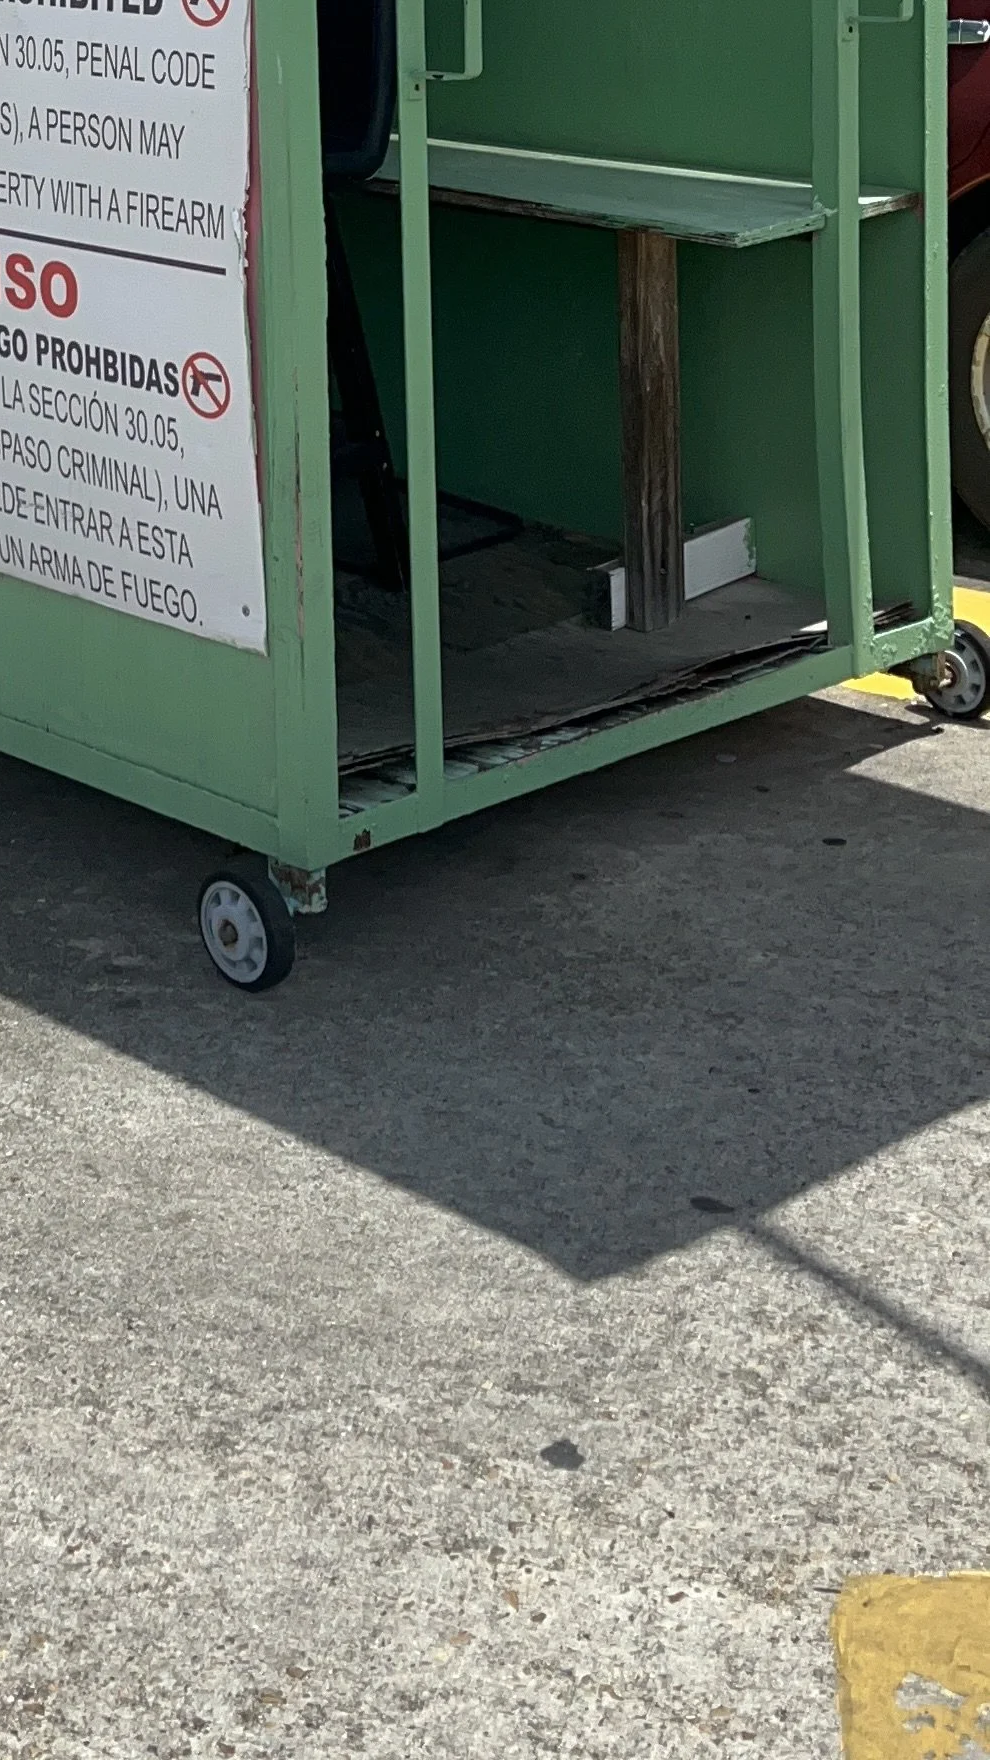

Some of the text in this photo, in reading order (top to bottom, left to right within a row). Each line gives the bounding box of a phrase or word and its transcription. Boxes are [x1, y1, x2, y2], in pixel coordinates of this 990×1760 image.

[15, 35, 69, 79] 30.05,
[76, 41, 145, 82] PENAL
[152, 49, 215, 89] CODE
[28, 106, 41, 140] A
[47, 108, 131, 152] PERSON
[140, 120, 185, 159] MAY
[51, 178, 101, 219] WITH
[107, 188, 121, 223] A
[127, 191, 224, 240] FIREARM
[36, 334, 179, 397] PROHBIDAS
[2, 376, 24, 413] LA
[29, 384, 117, 436] SECCIÓN
[125, 407, 184, 458] 30.05,
[58, 445, 168, 512] CRIMINAL),
[175, 475, 222, 519] UNA
[34, 492, 114, 545] ENTRAR
[120, 518, 133, 550] A
[138, 522, 193, 568] ESTA
[0, 534, 24, 568] UN
[30, 543, 85, 588] ARMA
[88, 560, 116, 599] DE
[121, 570, 203, 626] FUEGO.
